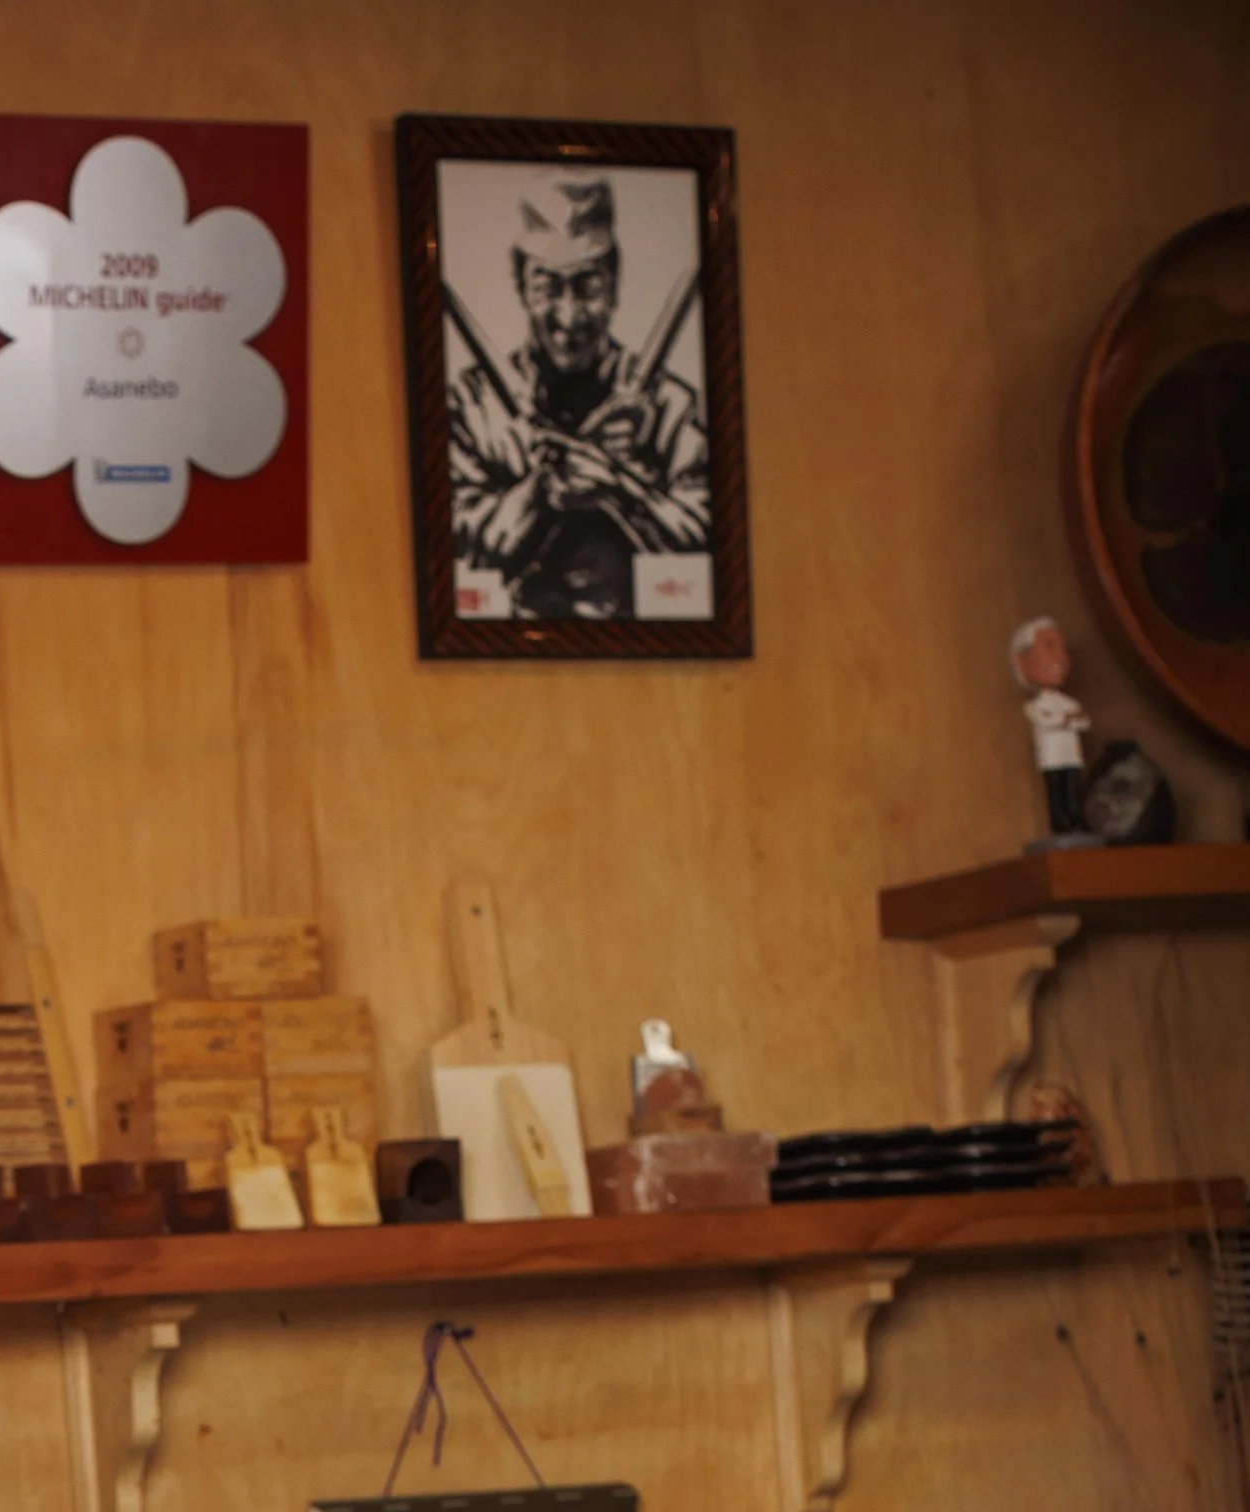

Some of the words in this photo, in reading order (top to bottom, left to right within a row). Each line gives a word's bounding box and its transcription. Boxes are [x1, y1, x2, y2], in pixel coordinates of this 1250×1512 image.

[101, 252, 160, 280] 2009
[29, 284, 149, 312] MICHELIN
[81, 376, 180, 400] Asanebo
